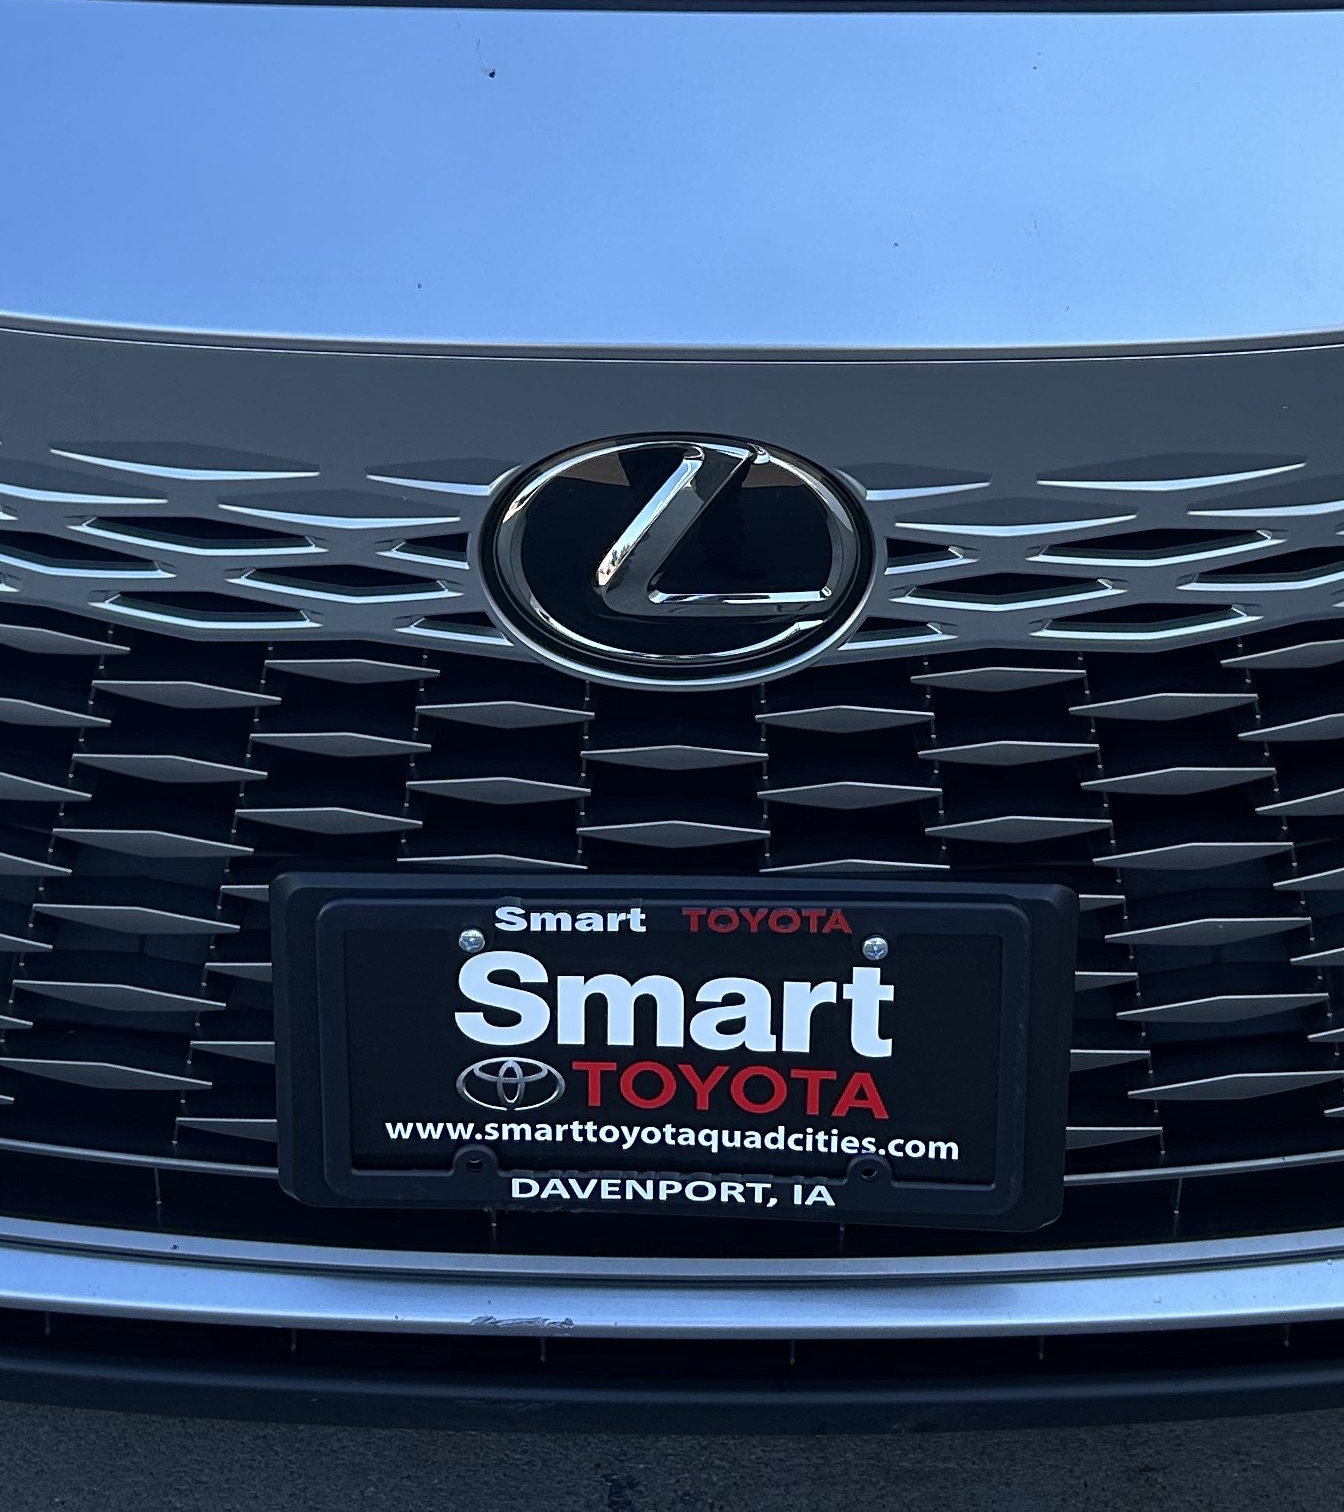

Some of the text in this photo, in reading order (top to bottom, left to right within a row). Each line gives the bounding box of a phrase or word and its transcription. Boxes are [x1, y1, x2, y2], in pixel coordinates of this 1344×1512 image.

[494, 906, 853, 934] Smart TOYOTA
[454, 950, 896, 1058] Smart
[572, 1060, 890, 1120] TOYOTA
[384, 1118, 960, 1161] www.smarttoyotaquadcities.com
[511, 1177, 836, 1209] DAVENPORT, IA
